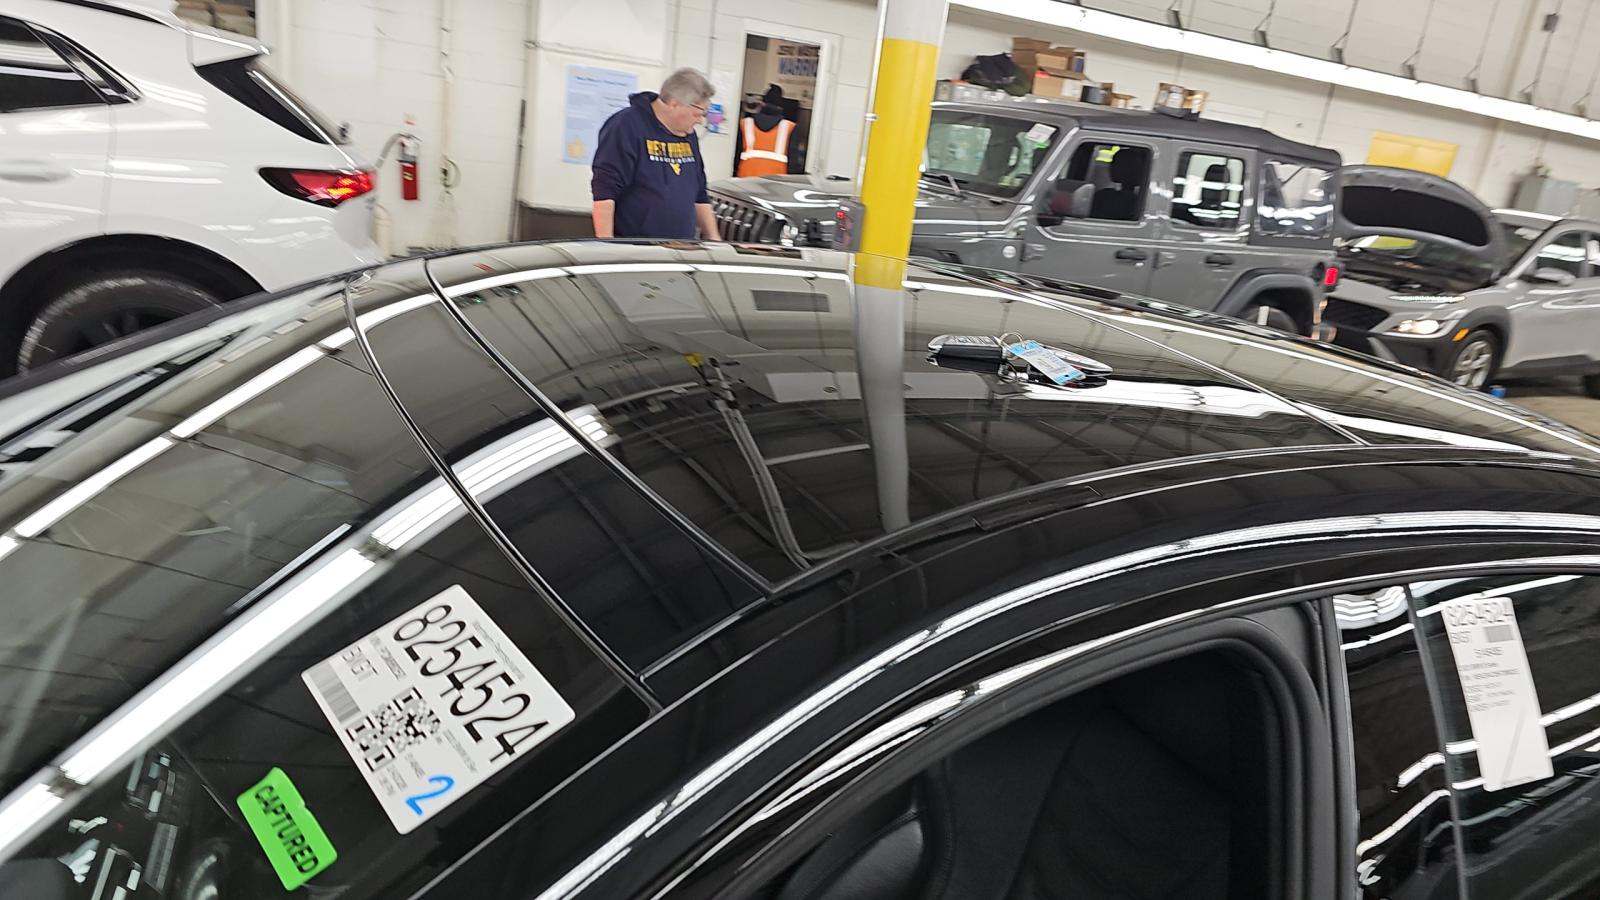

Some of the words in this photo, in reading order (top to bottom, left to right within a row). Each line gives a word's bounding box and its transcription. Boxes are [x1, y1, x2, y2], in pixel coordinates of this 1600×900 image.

[392, 604, 549, 764] 8254524
[254, 784, 319, 874] CAPTURED
[405, 774, 455, 816] 2
